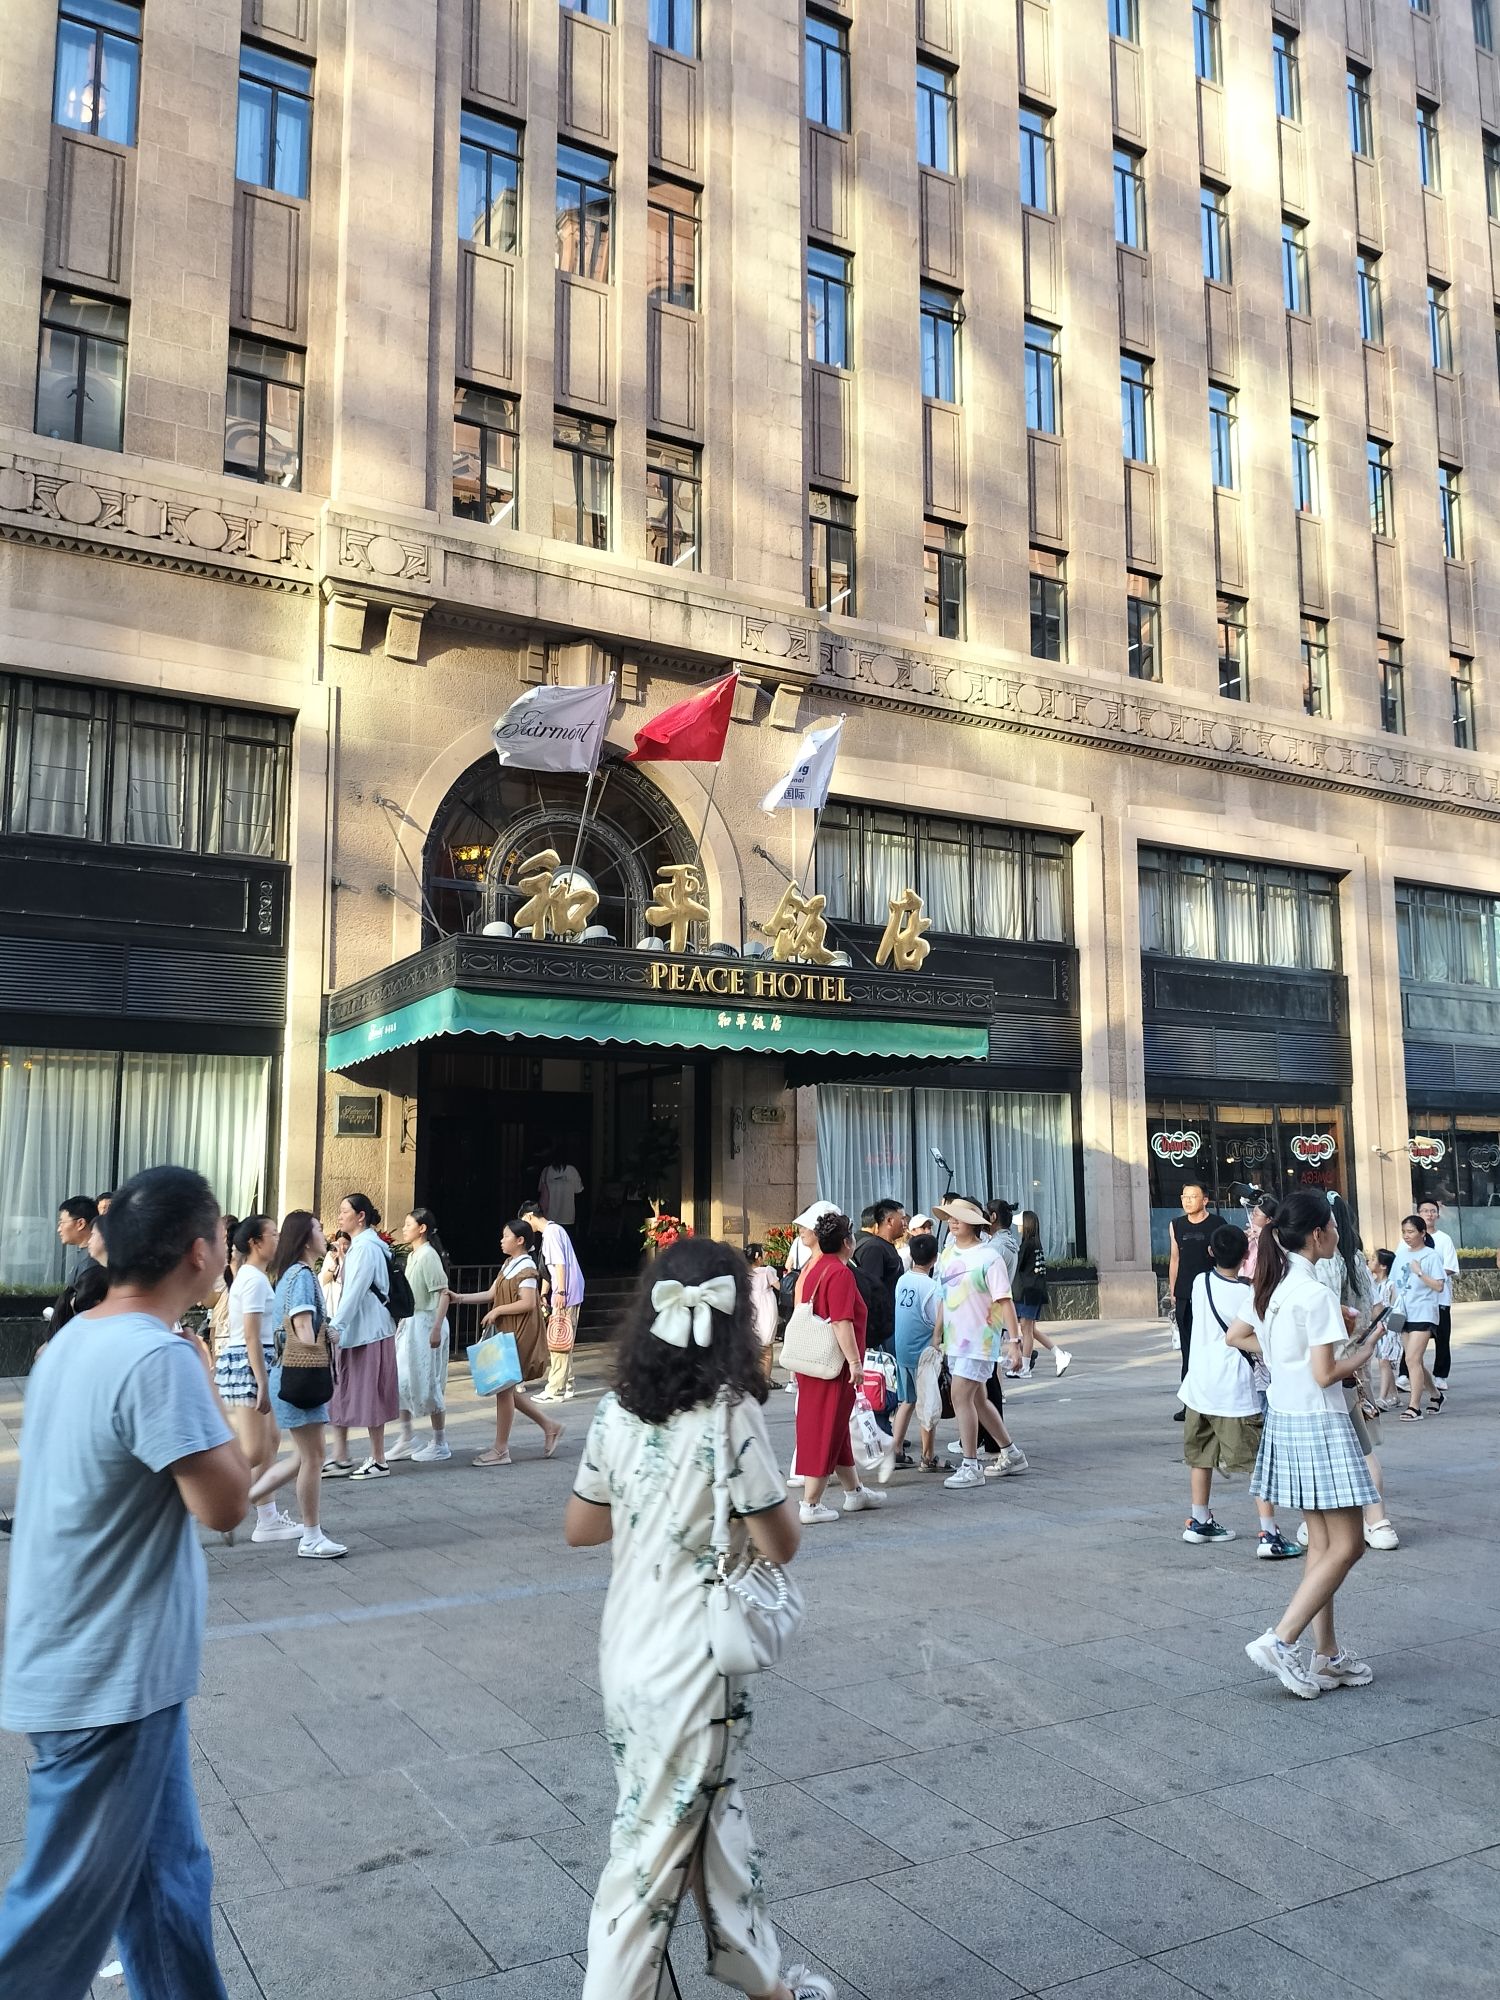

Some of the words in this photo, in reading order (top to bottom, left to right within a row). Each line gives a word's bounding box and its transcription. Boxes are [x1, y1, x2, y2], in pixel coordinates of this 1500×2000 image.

[496, 710, 598, 742] Fairmont
[781, 787, 806, 800] 国际
[514, 849, 932, 971] 和平饭店
[650, 962, 745, 995] PEACE
[754, 970, 851, 1002] HOTEL
[718, 1011, 782, 1031] 和平饭店
[900, 1288, 915, 1307] 23
